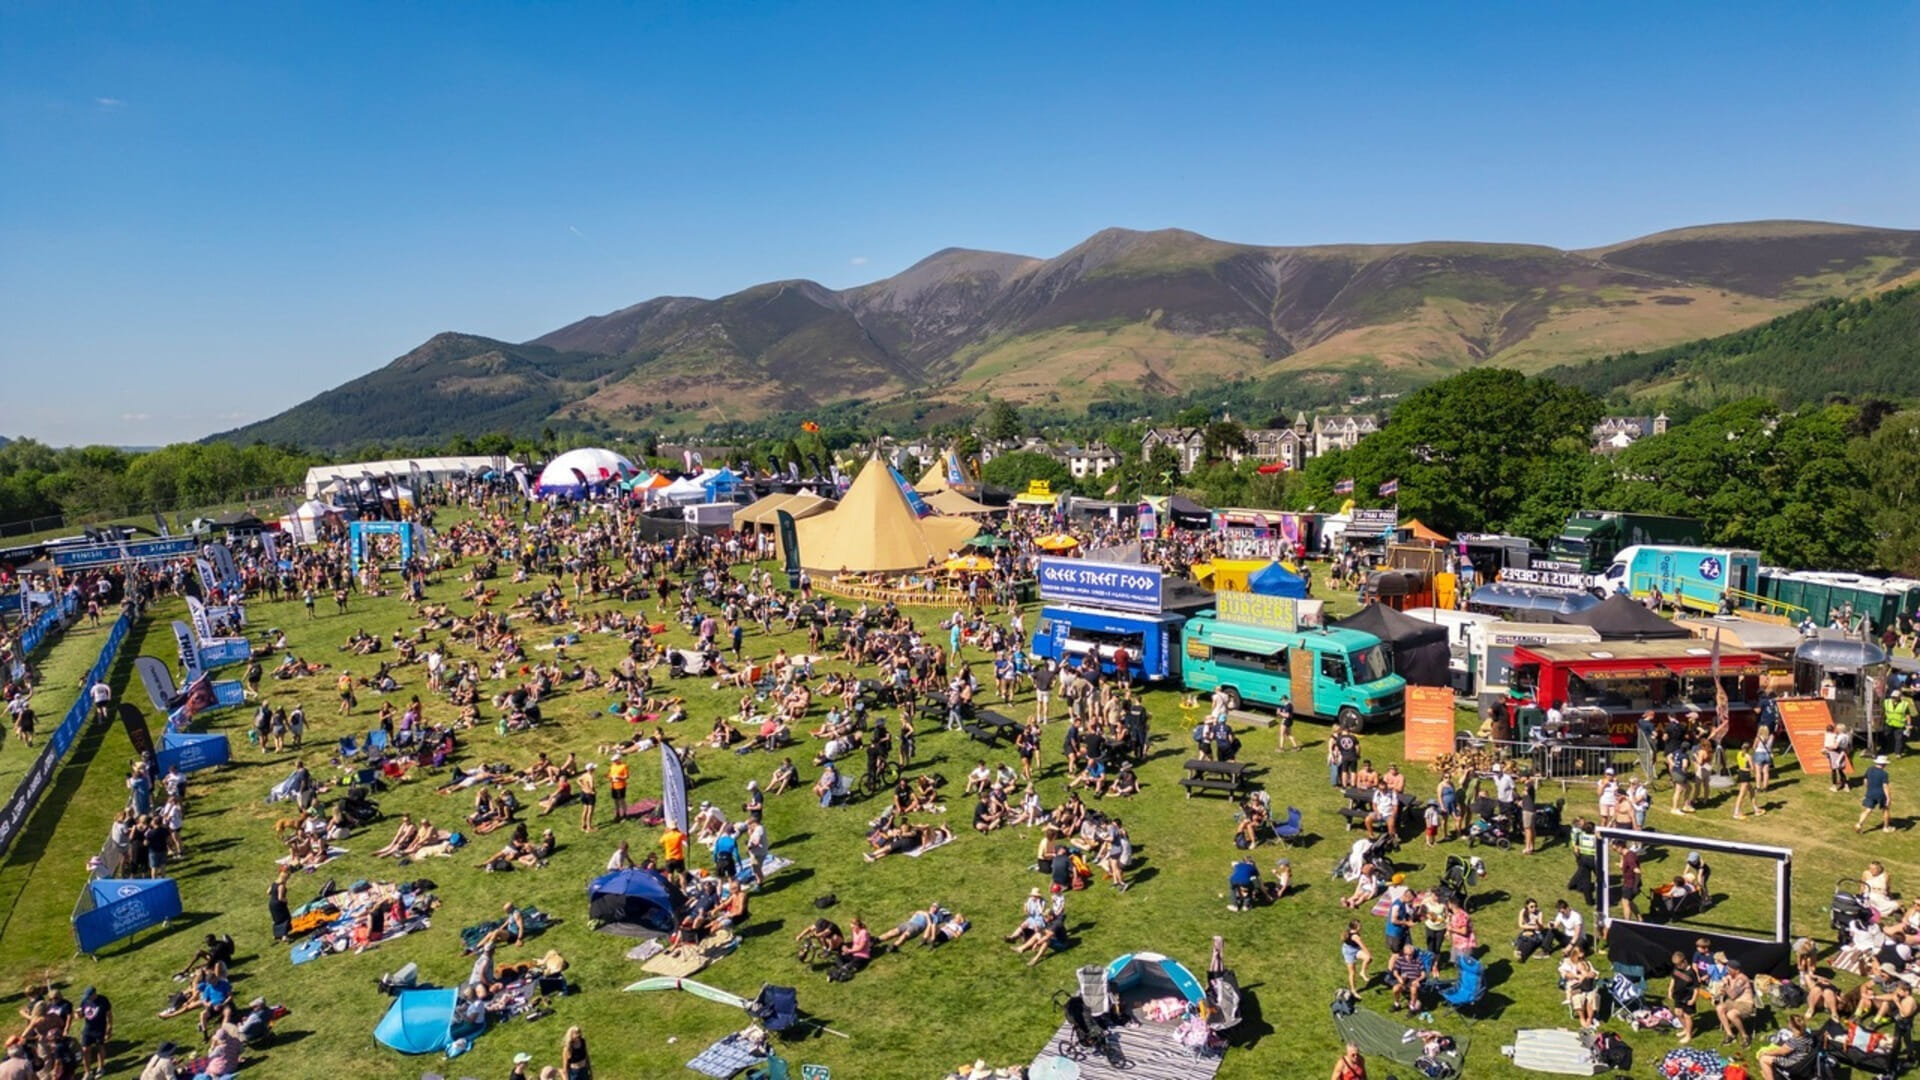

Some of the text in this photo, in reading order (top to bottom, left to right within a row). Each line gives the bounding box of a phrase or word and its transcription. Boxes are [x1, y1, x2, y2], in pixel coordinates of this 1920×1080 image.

[149, 542, 176, 552] START
[72, 551, 103, 561] FINISH
[1044, 566, 1155, 591] GREEK STREET FOOD
[1219, 599, 1293, 623] BURGERS
